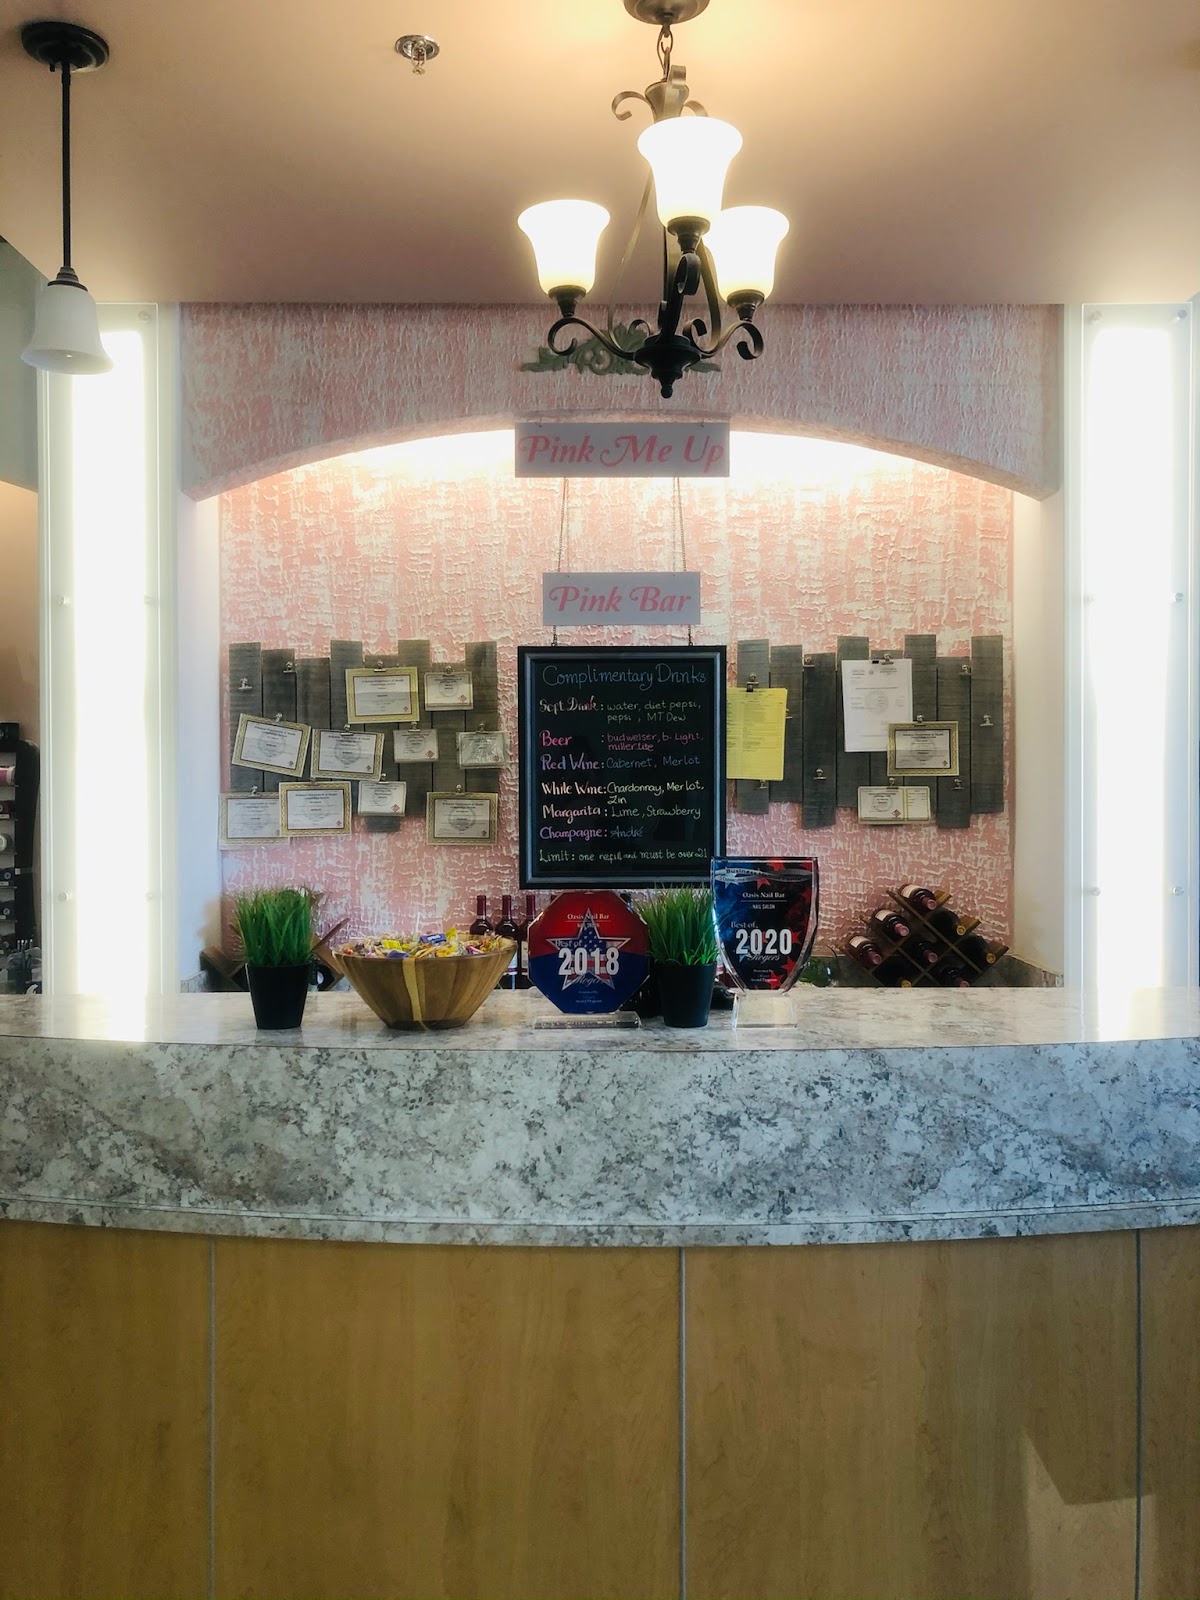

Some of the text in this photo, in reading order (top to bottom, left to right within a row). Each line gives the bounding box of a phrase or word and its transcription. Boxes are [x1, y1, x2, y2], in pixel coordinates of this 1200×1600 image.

[518, 435, 725, 473] Pink Me Up
[549, 585, 692, 612] Pink Bar
[542, 662, 707, 691] Complimentary Drinks
[644, 700, 666, 710] diet
[647, 712, 664, 721] MT
[666, 712, 686, 721] Dew
[539, 729, 573, 747] Beer
[540, 753, 567, 771] Red
[662, 755, 700, 766] Merlot
[541, 781, 573, 795] White
[607, 795, 627, 804] Zin
[646, 804, 701, 820] Strawberry
[578, 853, 595, 861] one
[599, 851, 622, 864] refill
[639, 849, 663, 860] must
[665, 849, 676, 859] be
[735, 929, 792, 955] 2020
[558, 947, 620, 976] 2018
